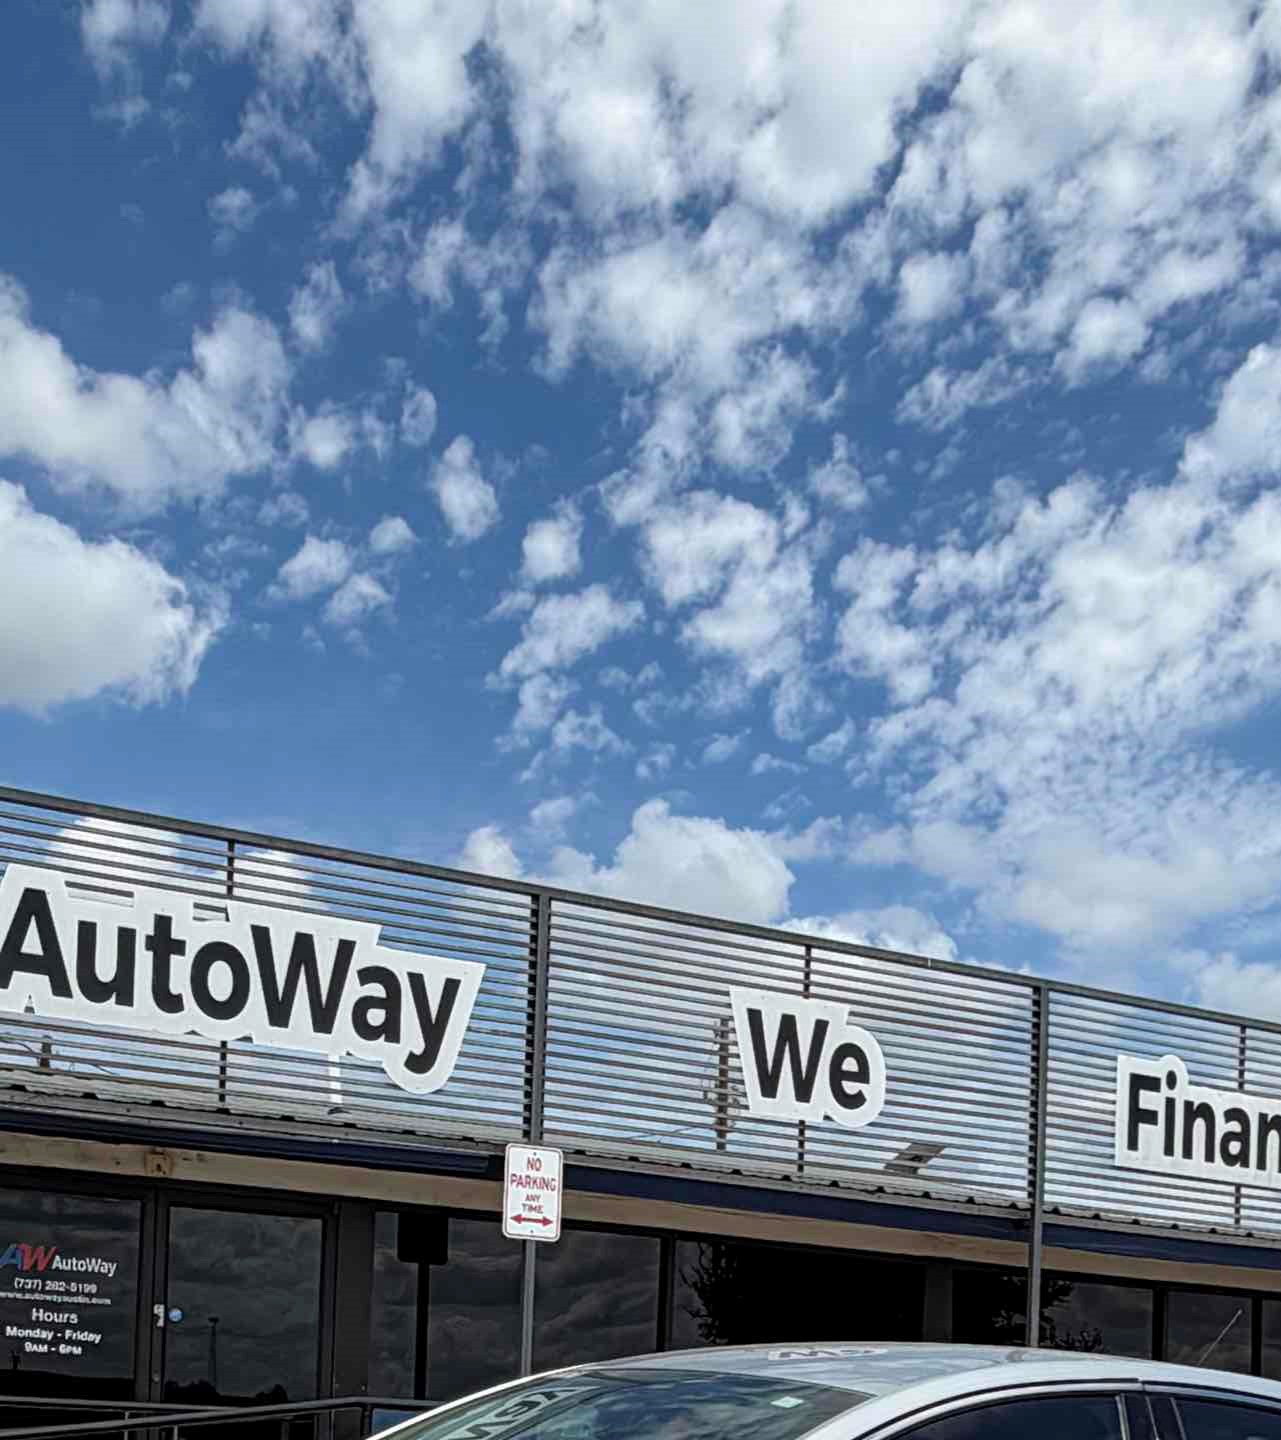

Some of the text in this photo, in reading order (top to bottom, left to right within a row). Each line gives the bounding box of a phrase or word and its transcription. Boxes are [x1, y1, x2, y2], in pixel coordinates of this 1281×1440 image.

[746, 1008, 871, 1111] We
[527, 1157, 542, 1171] NO
[510, 1174, 556, 1191] PARKING
[525, 1194, 541, 1203] ANY
[522, 1203, 544, 1214] TIME
[52, 1255, 117, 1277] AutoWay
[14, 1277, 42, 1291] (737)
[31, 1308, 78, 1324] Hours
[6, 1326, 54, 1340] Monday
[65, 1329, 102, 1344] Friday
